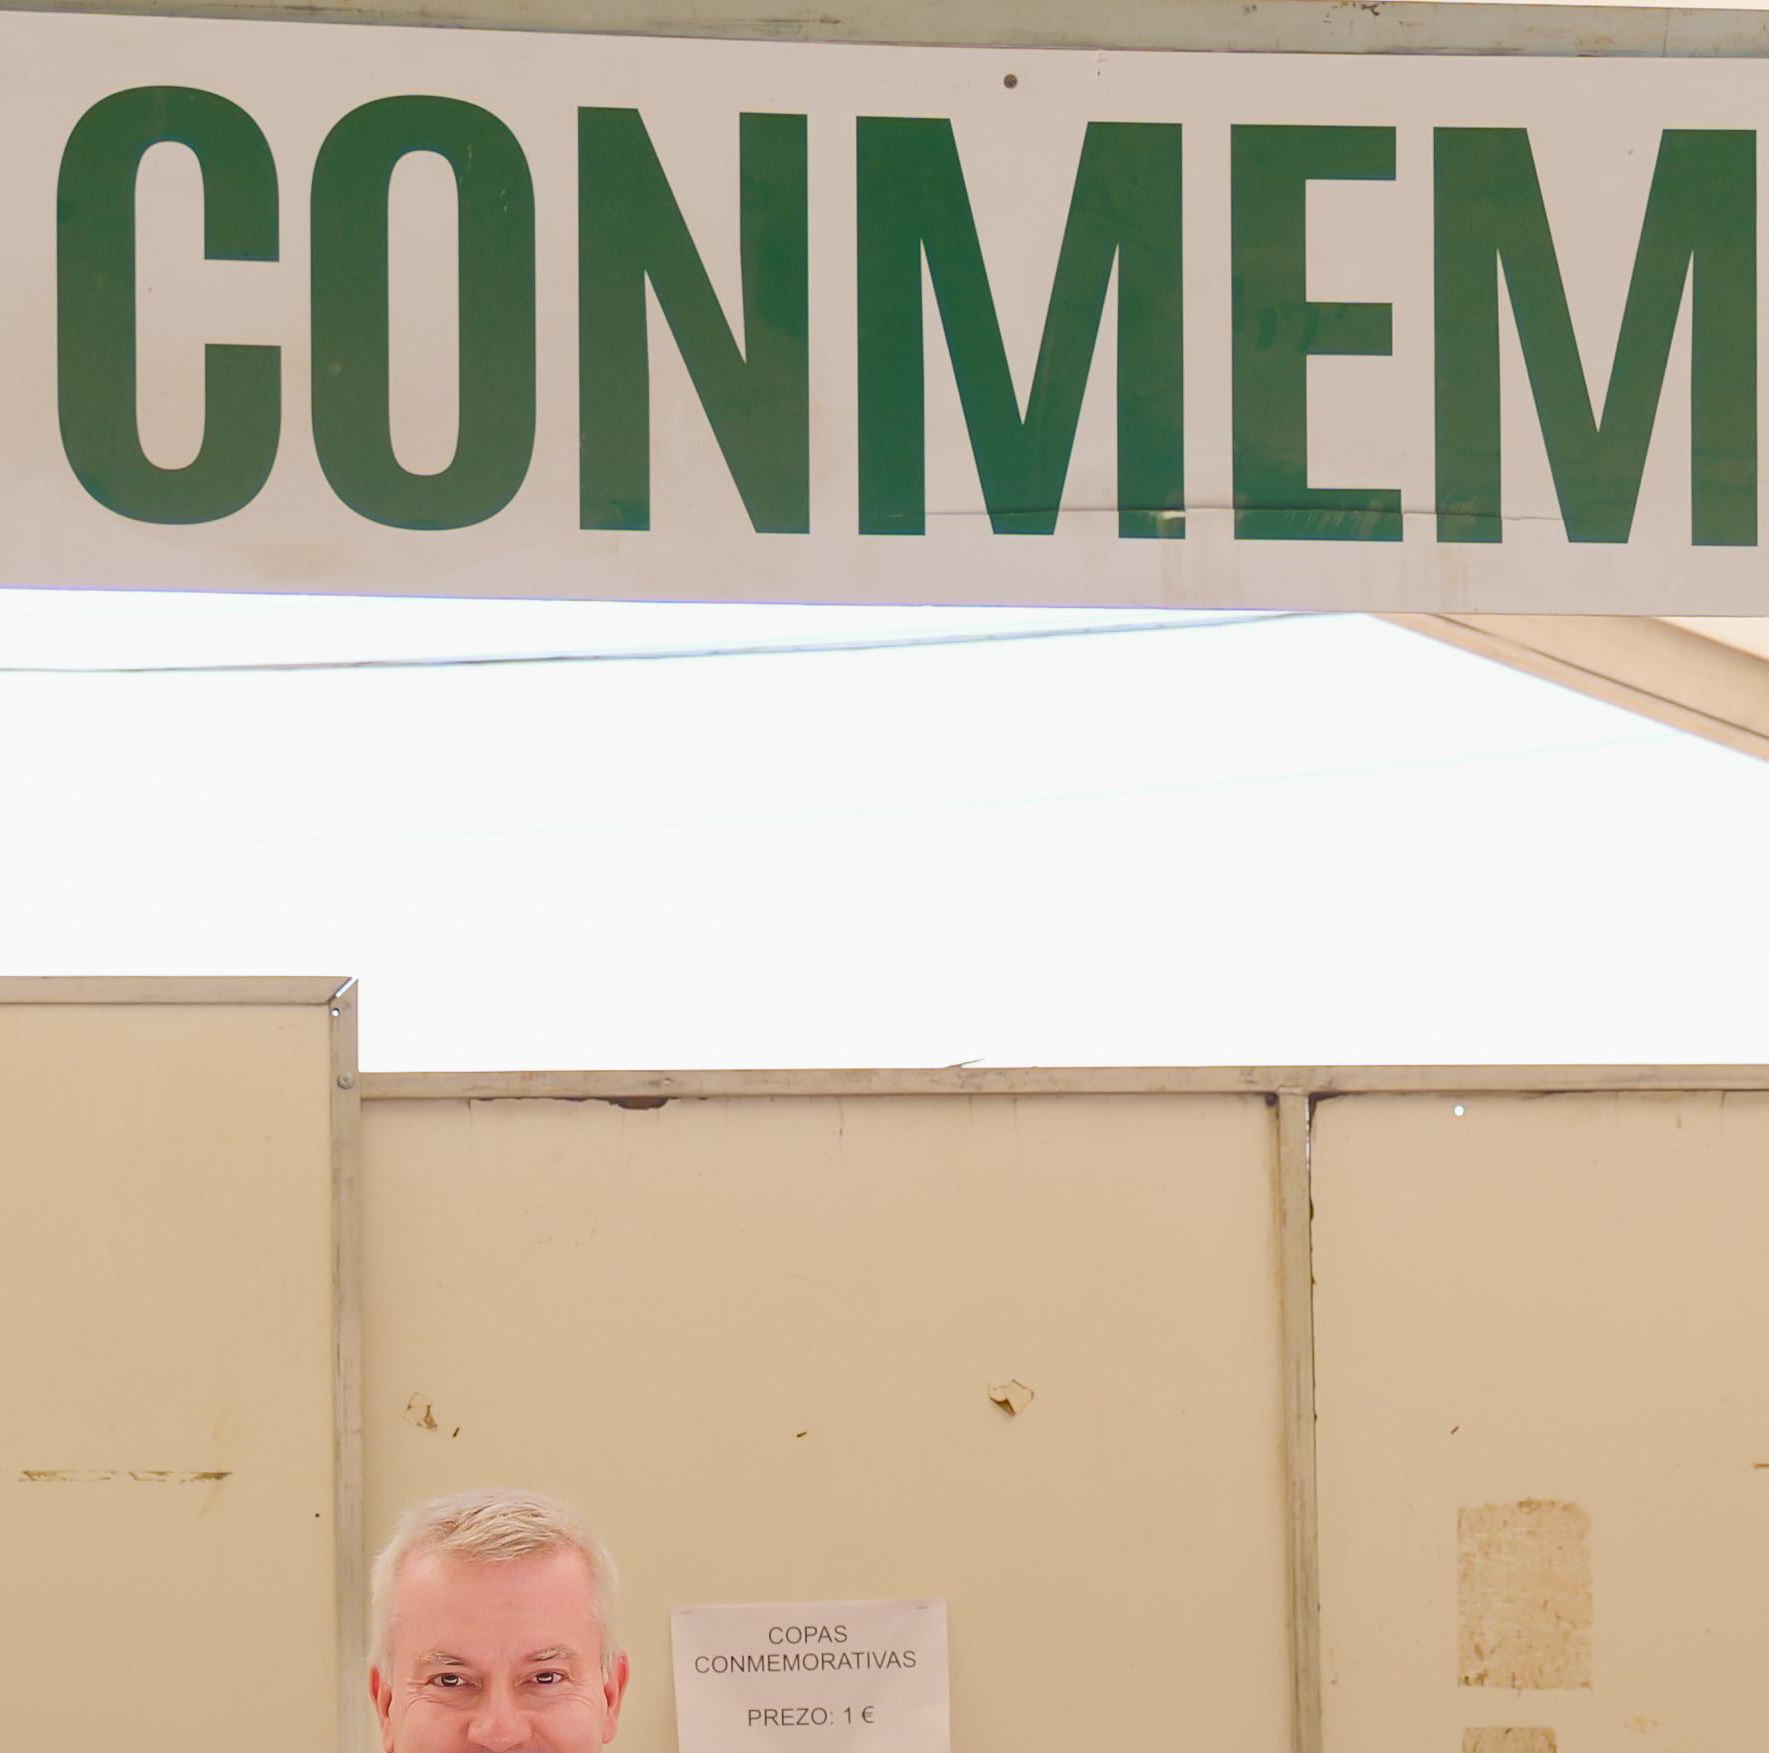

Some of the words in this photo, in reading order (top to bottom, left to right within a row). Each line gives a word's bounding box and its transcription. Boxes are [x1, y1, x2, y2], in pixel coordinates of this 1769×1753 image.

[768, 1624, 848, 1645] COPAS
[694, 1650, 917, 1674] CONMEMORATIVAS
[748, 1707, 834, 1727] PREZO:
[843, 1706, 852, 1724] 1
[861, 1705, 875, 1724] €
